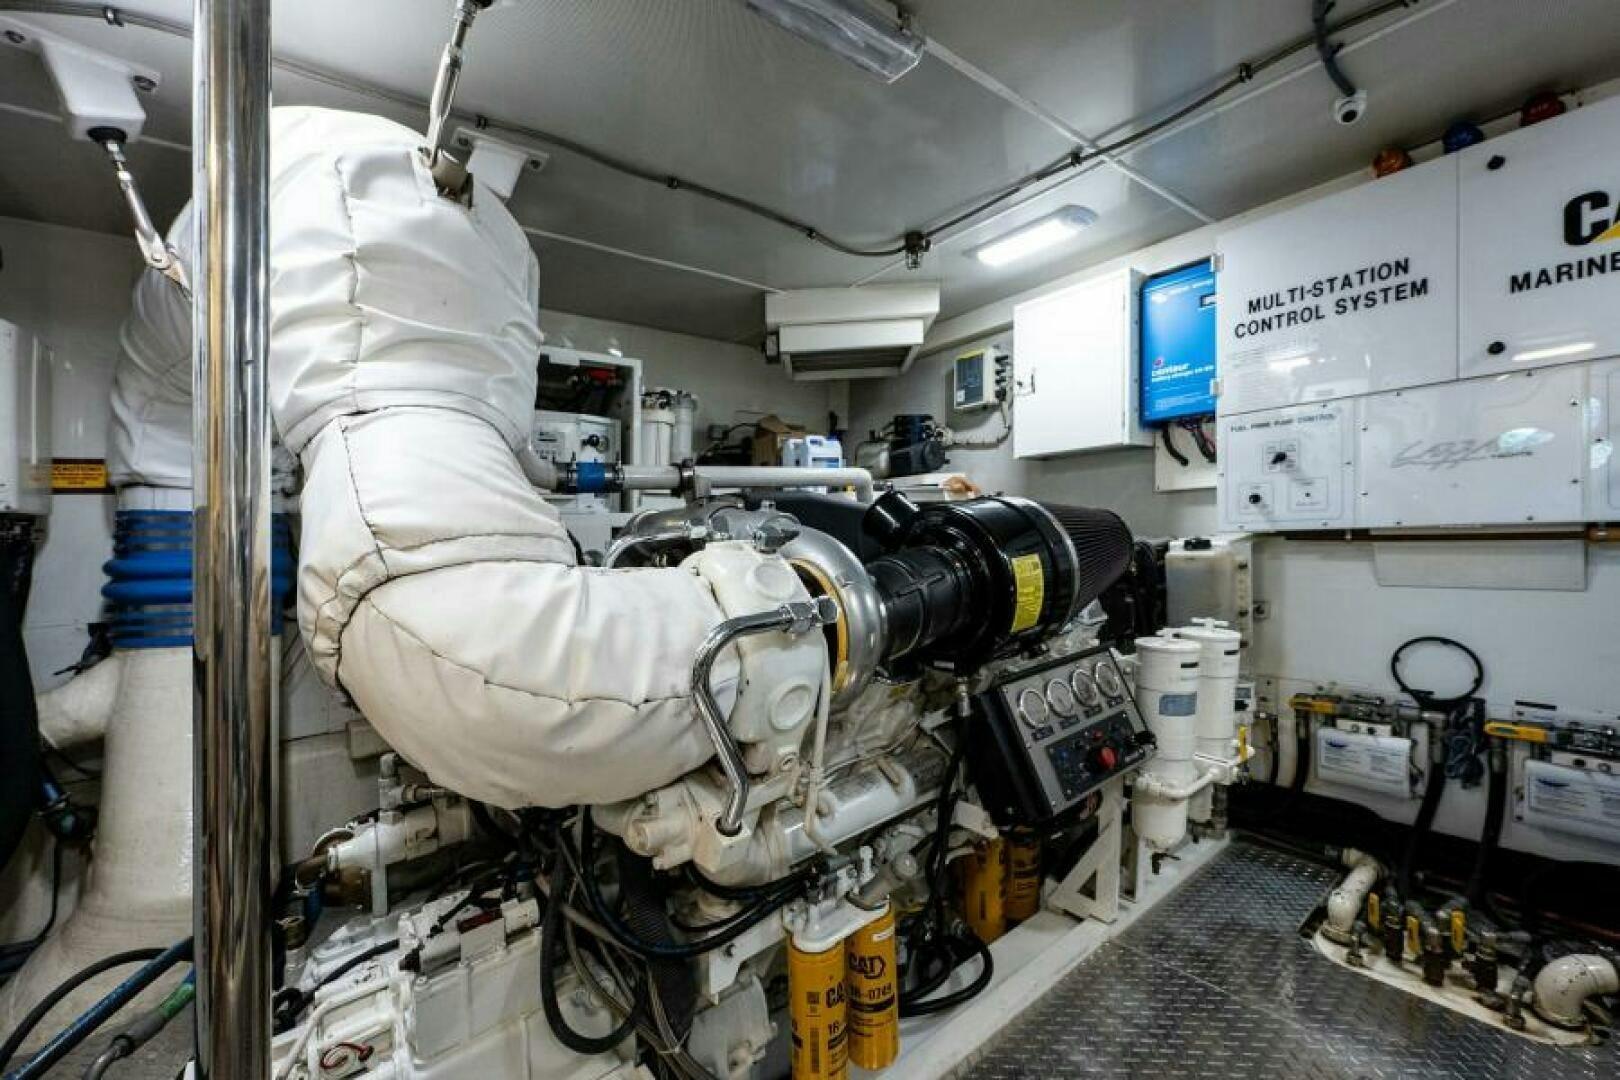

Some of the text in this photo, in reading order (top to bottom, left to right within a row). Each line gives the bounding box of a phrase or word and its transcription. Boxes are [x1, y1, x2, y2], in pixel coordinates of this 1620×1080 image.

[1234, 278, 1429, 339] CONTROL SYSTEM
[1247, 257, 1410, 315] MULTI-STATION
